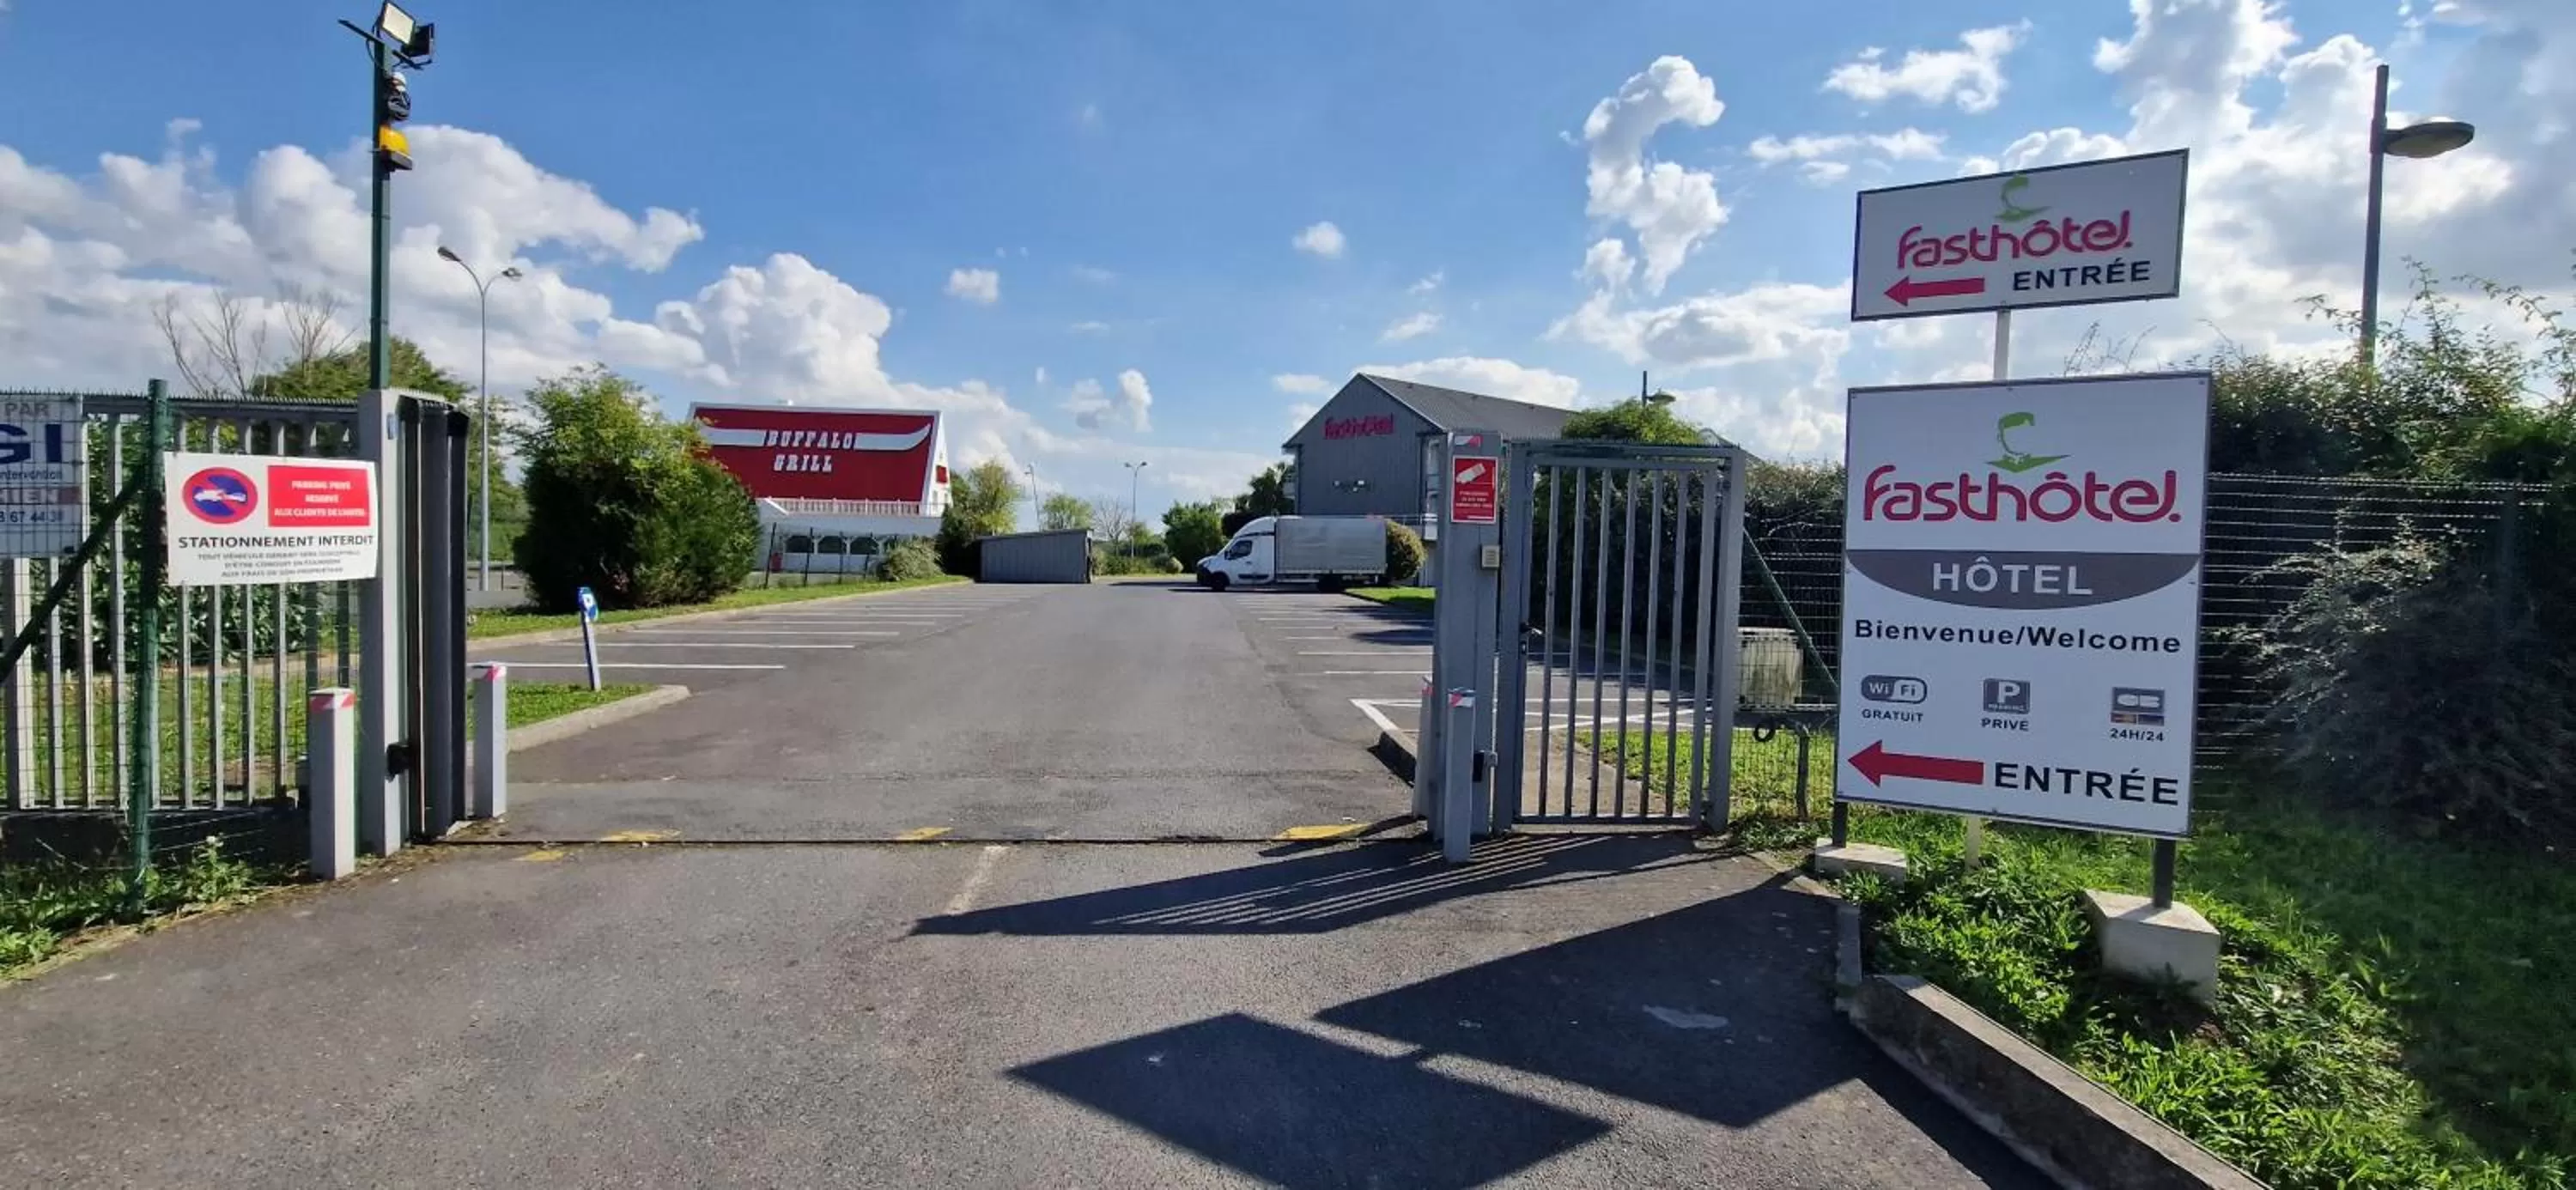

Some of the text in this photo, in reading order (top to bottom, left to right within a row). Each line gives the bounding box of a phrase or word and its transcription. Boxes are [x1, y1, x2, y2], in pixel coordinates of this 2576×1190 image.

[2012, 258, 2151, 292] ENTRÉE
[767, 429, 853, 449] BUFFALO
[774, 454, 832, 472] GRILL
[178, 535, 374, 549] STATIONNEMENT INTERDIT
[1932, 556, 2093, 595] HÔTEL
[1855, 619, 2181, 653] Bienvenue/Welcome
[1997, 681, 2020, 703] P
[1861, 708, 1924, 722] GRATUIT
[2110, 727, 2164, 742] 24H/24
[1994, 762, 2179, 805] ENTRÉE
